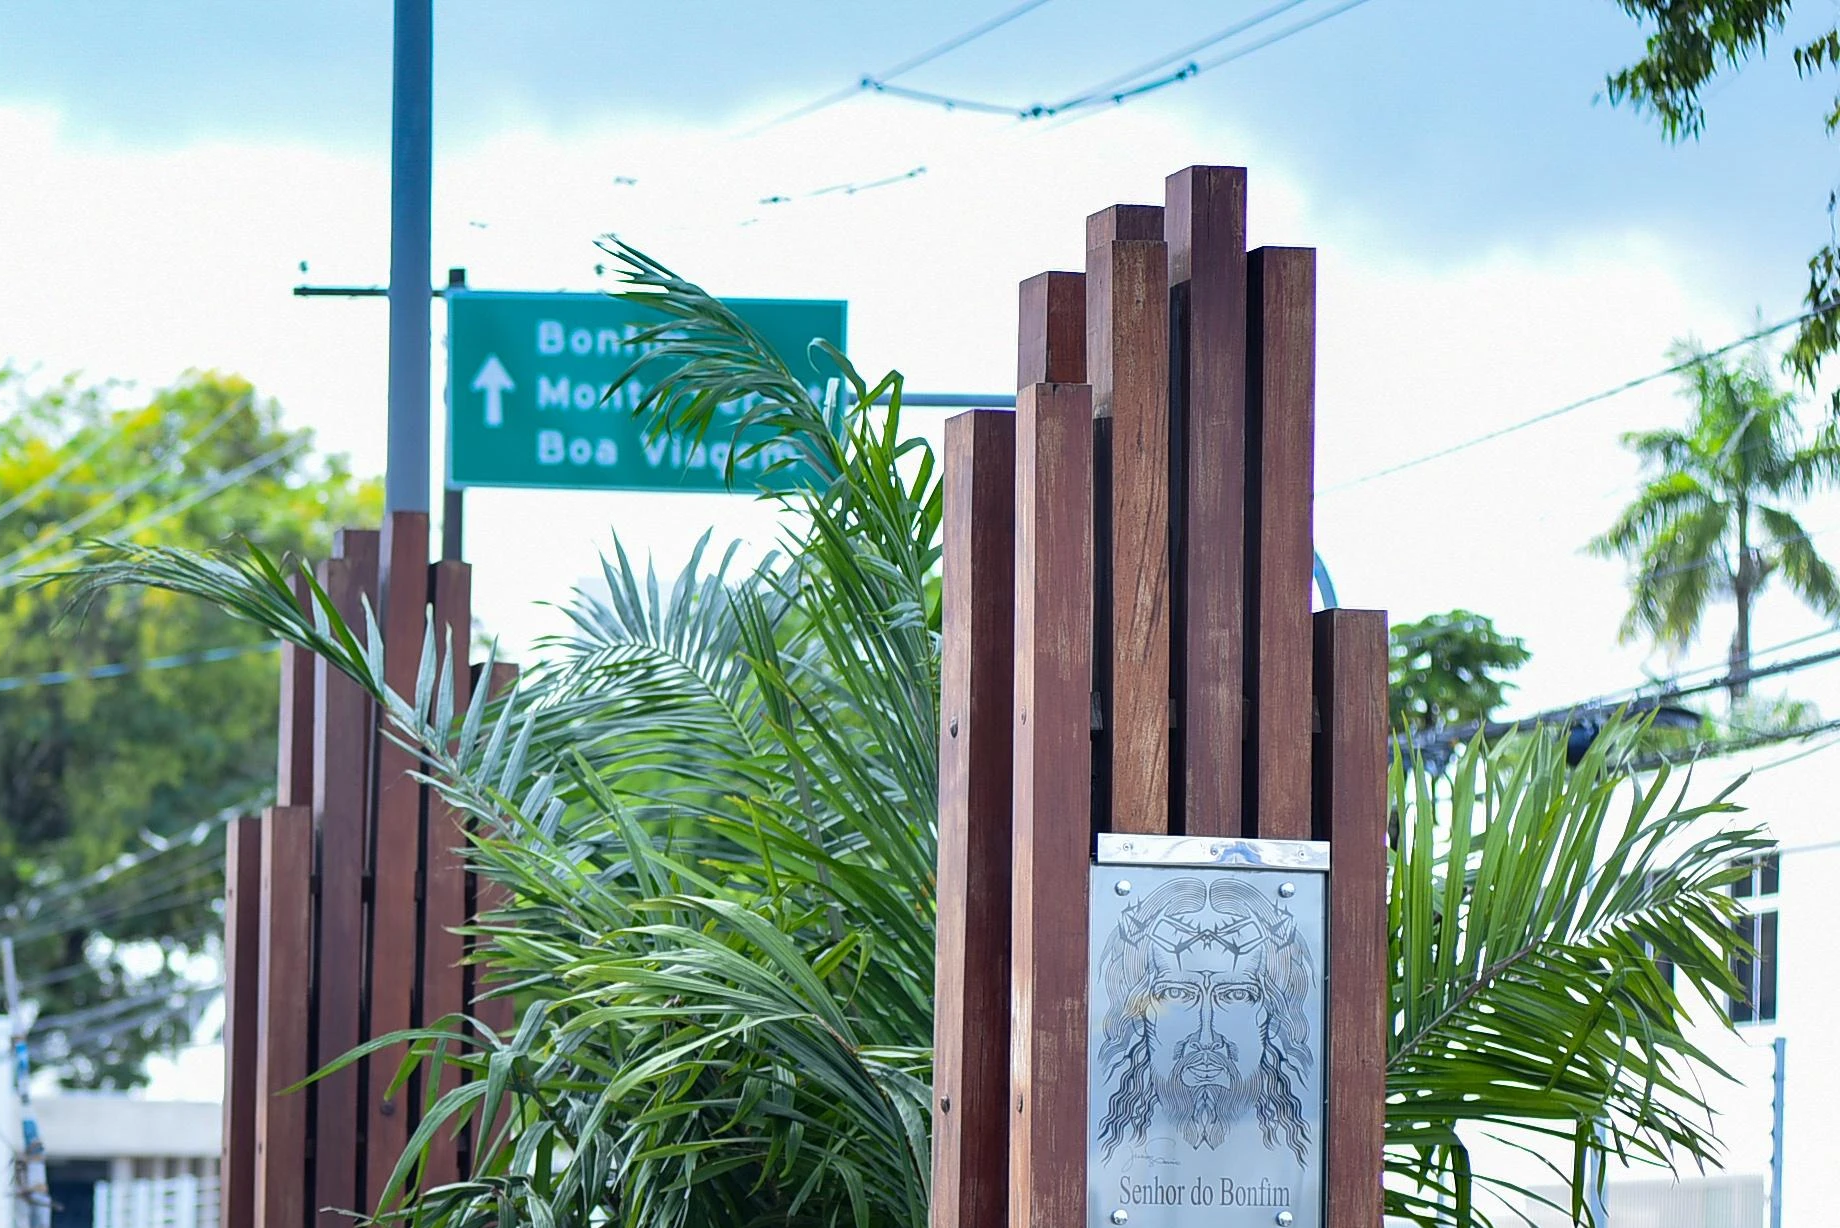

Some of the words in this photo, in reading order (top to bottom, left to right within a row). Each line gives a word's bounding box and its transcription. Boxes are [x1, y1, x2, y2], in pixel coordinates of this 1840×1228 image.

[538, 320, 689, 355] Bonf
[538, 430, 618, 465] Boa
[641, 432, 798, 481] Viagem
[1120, 1176, 1185, 1206] Senhor
[1191, 1177, 1213, 1206] do
[1221, 1177, 1290, 1208] Bonfim
